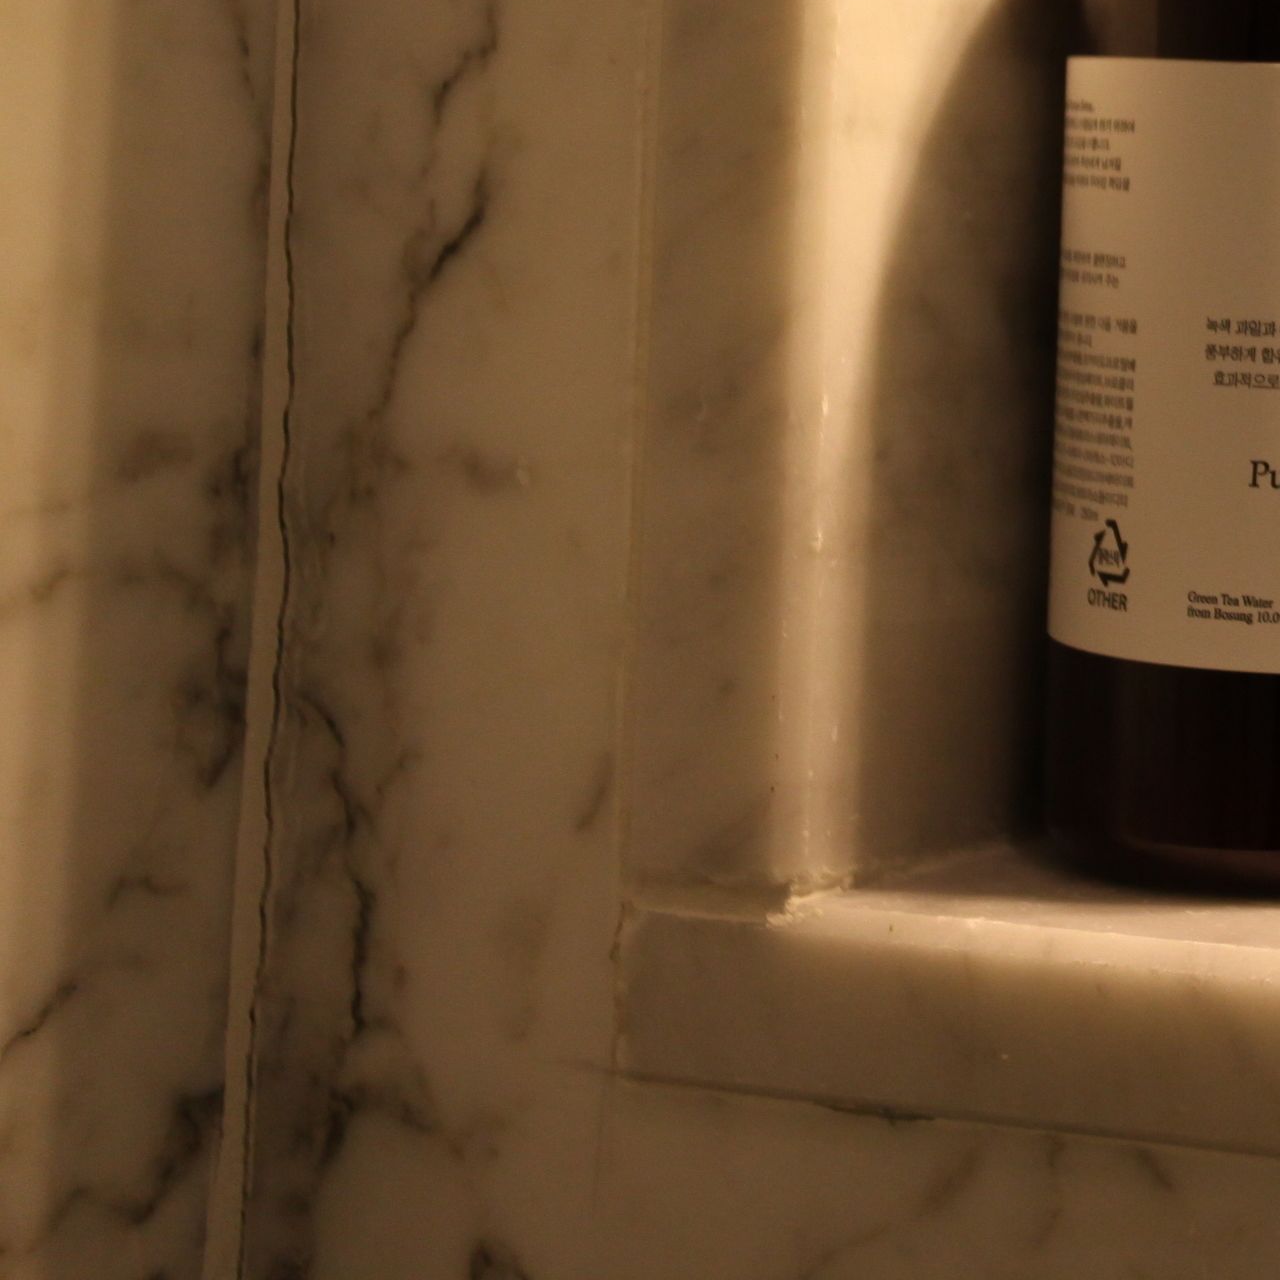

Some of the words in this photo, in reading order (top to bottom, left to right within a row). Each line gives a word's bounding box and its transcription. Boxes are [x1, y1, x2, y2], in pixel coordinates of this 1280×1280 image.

[1236, 319, 1276, 337] 과일과
[1213, 370, 1280, 390] 효과적으로
[1087, 587, 1128, 613] OTHER
[1187, 590, 1218, 605] Green
[1221, 593, 1240, 607] Tea
[1241, 594, 1274, 609] Water
[1187, 604, 1211, 618] from
[1214, 607, 1253, 625] Bosung
